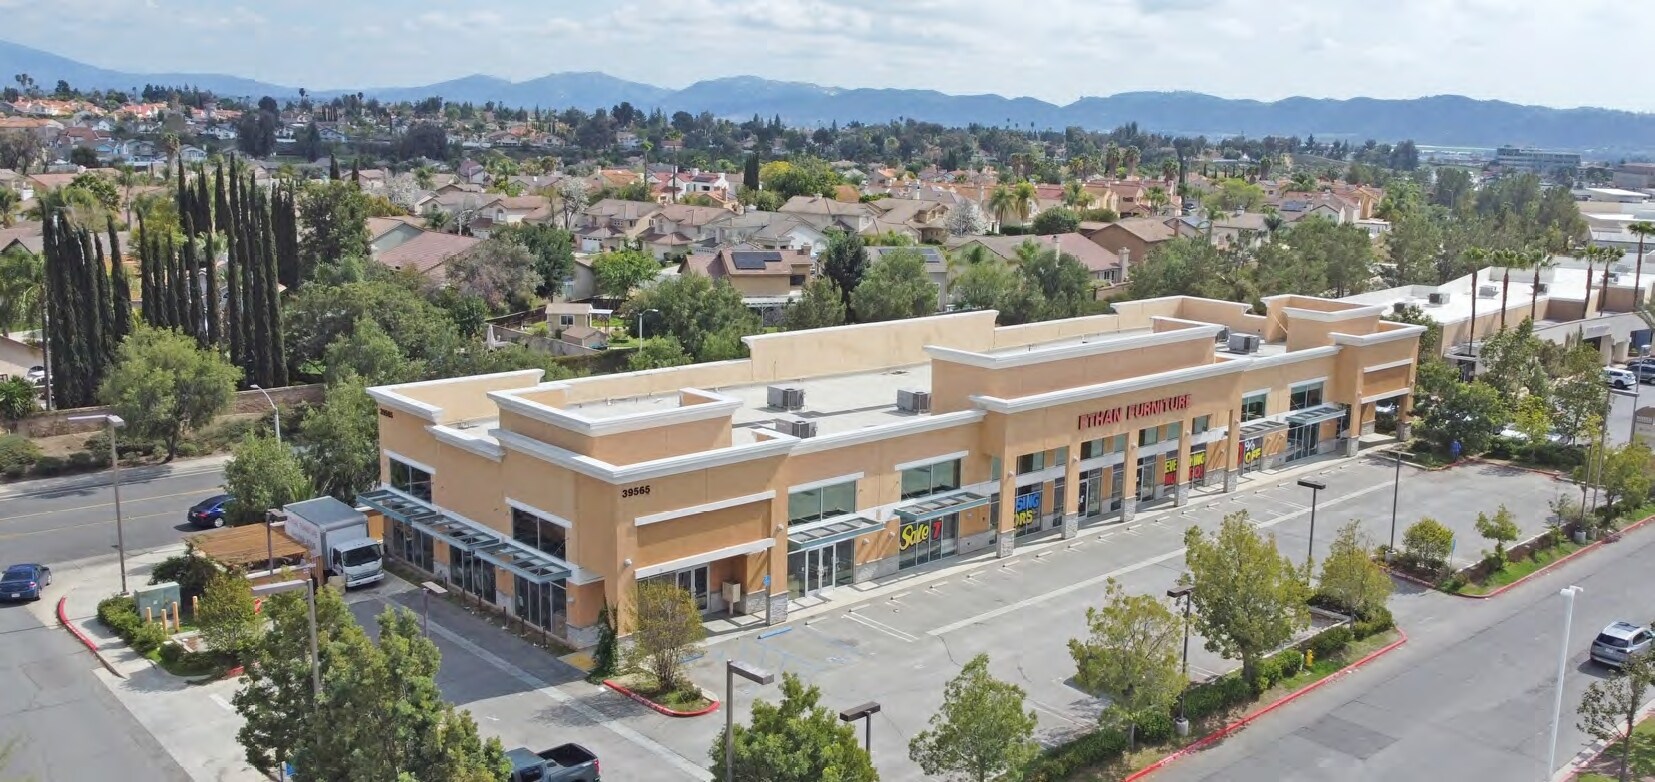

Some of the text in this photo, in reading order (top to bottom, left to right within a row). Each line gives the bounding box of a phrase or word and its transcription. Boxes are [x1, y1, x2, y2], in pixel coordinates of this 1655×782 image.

[1078, 394, 1192, 430] ETHAN FURNITURE
[1164, 458, 1178, 473] EVE
[622, 484, 650, 498] 39565
[1016, 493, 1040, 512] SING
[1014, 509, 1033, 527] ORS
[900, 524, 929, 551] Sale
